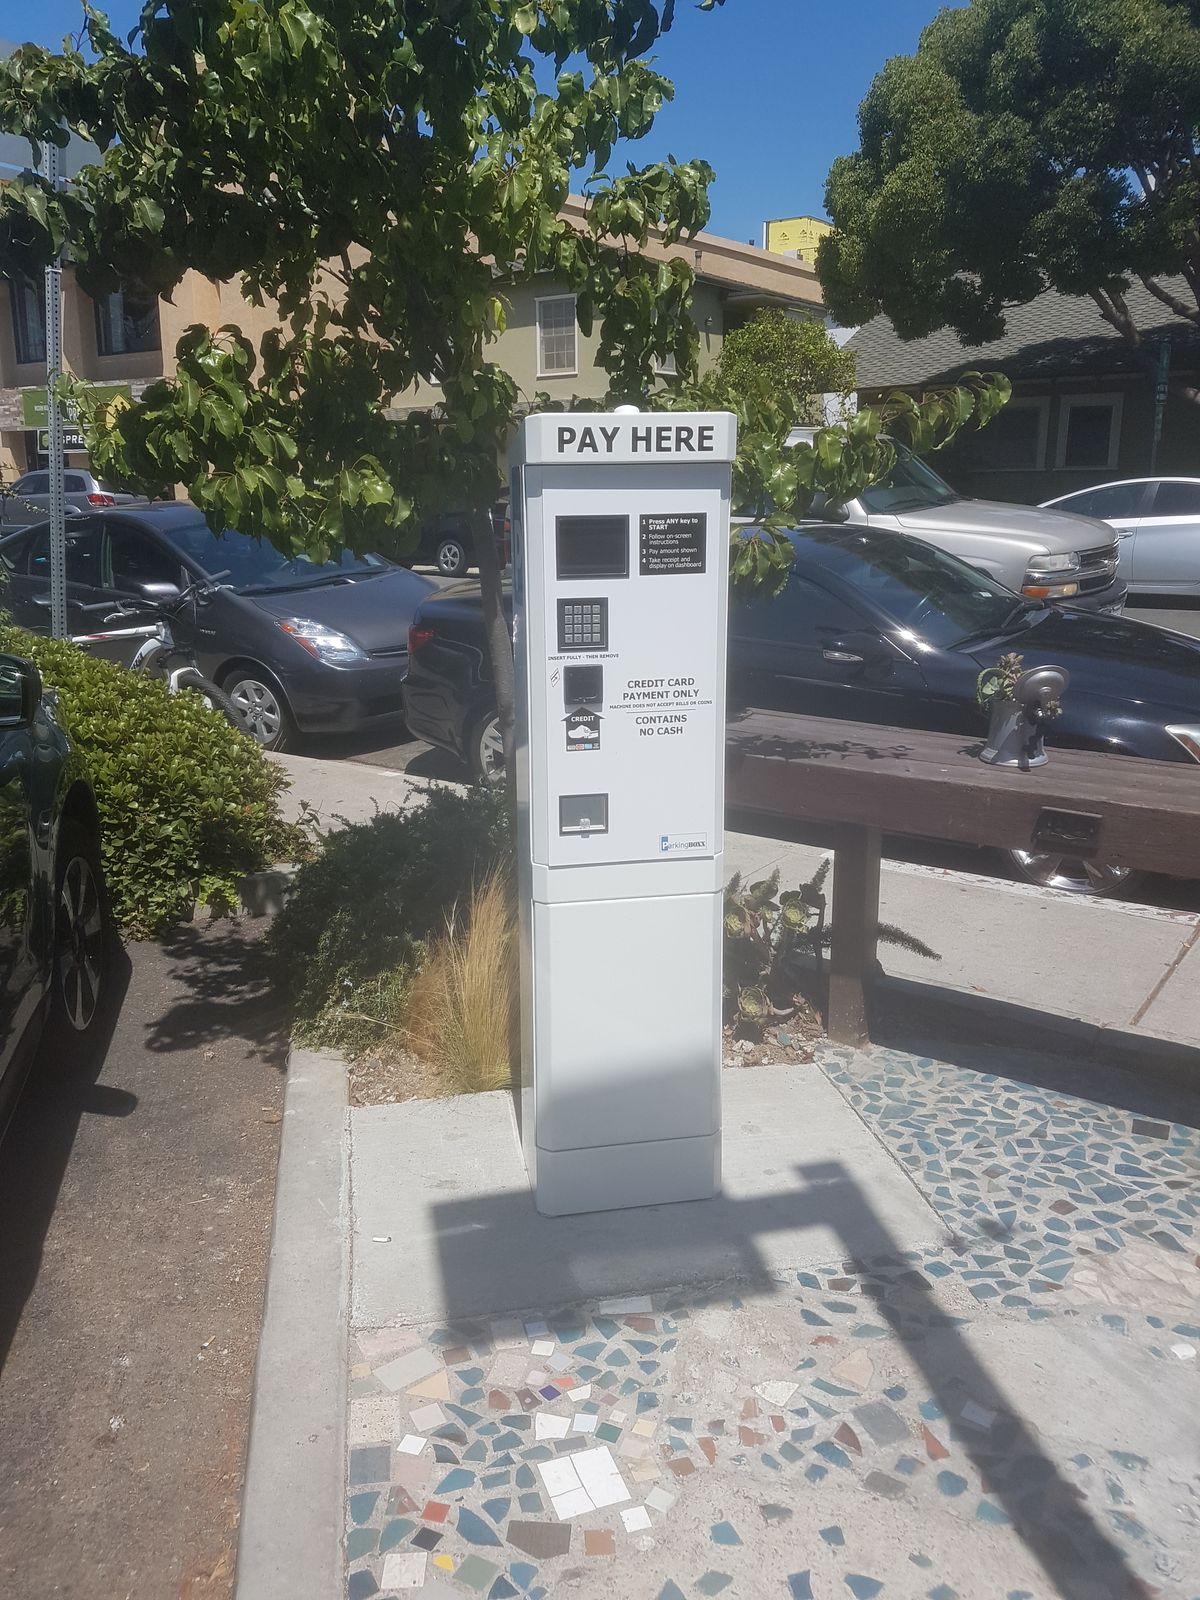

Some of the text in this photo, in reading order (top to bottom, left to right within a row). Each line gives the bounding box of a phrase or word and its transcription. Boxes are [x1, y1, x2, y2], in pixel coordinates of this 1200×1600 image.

[557, 426, 714, 453] PAY HERE
[680, 517, 690, 525] key
[627, 678, 695, 689] CREDIT CARD
[623, 689, 699, 701] PAYMENT ONLY
[635, 714, 687, 725] CONTAINS
[640, 726, 683, 736] NO CASH
